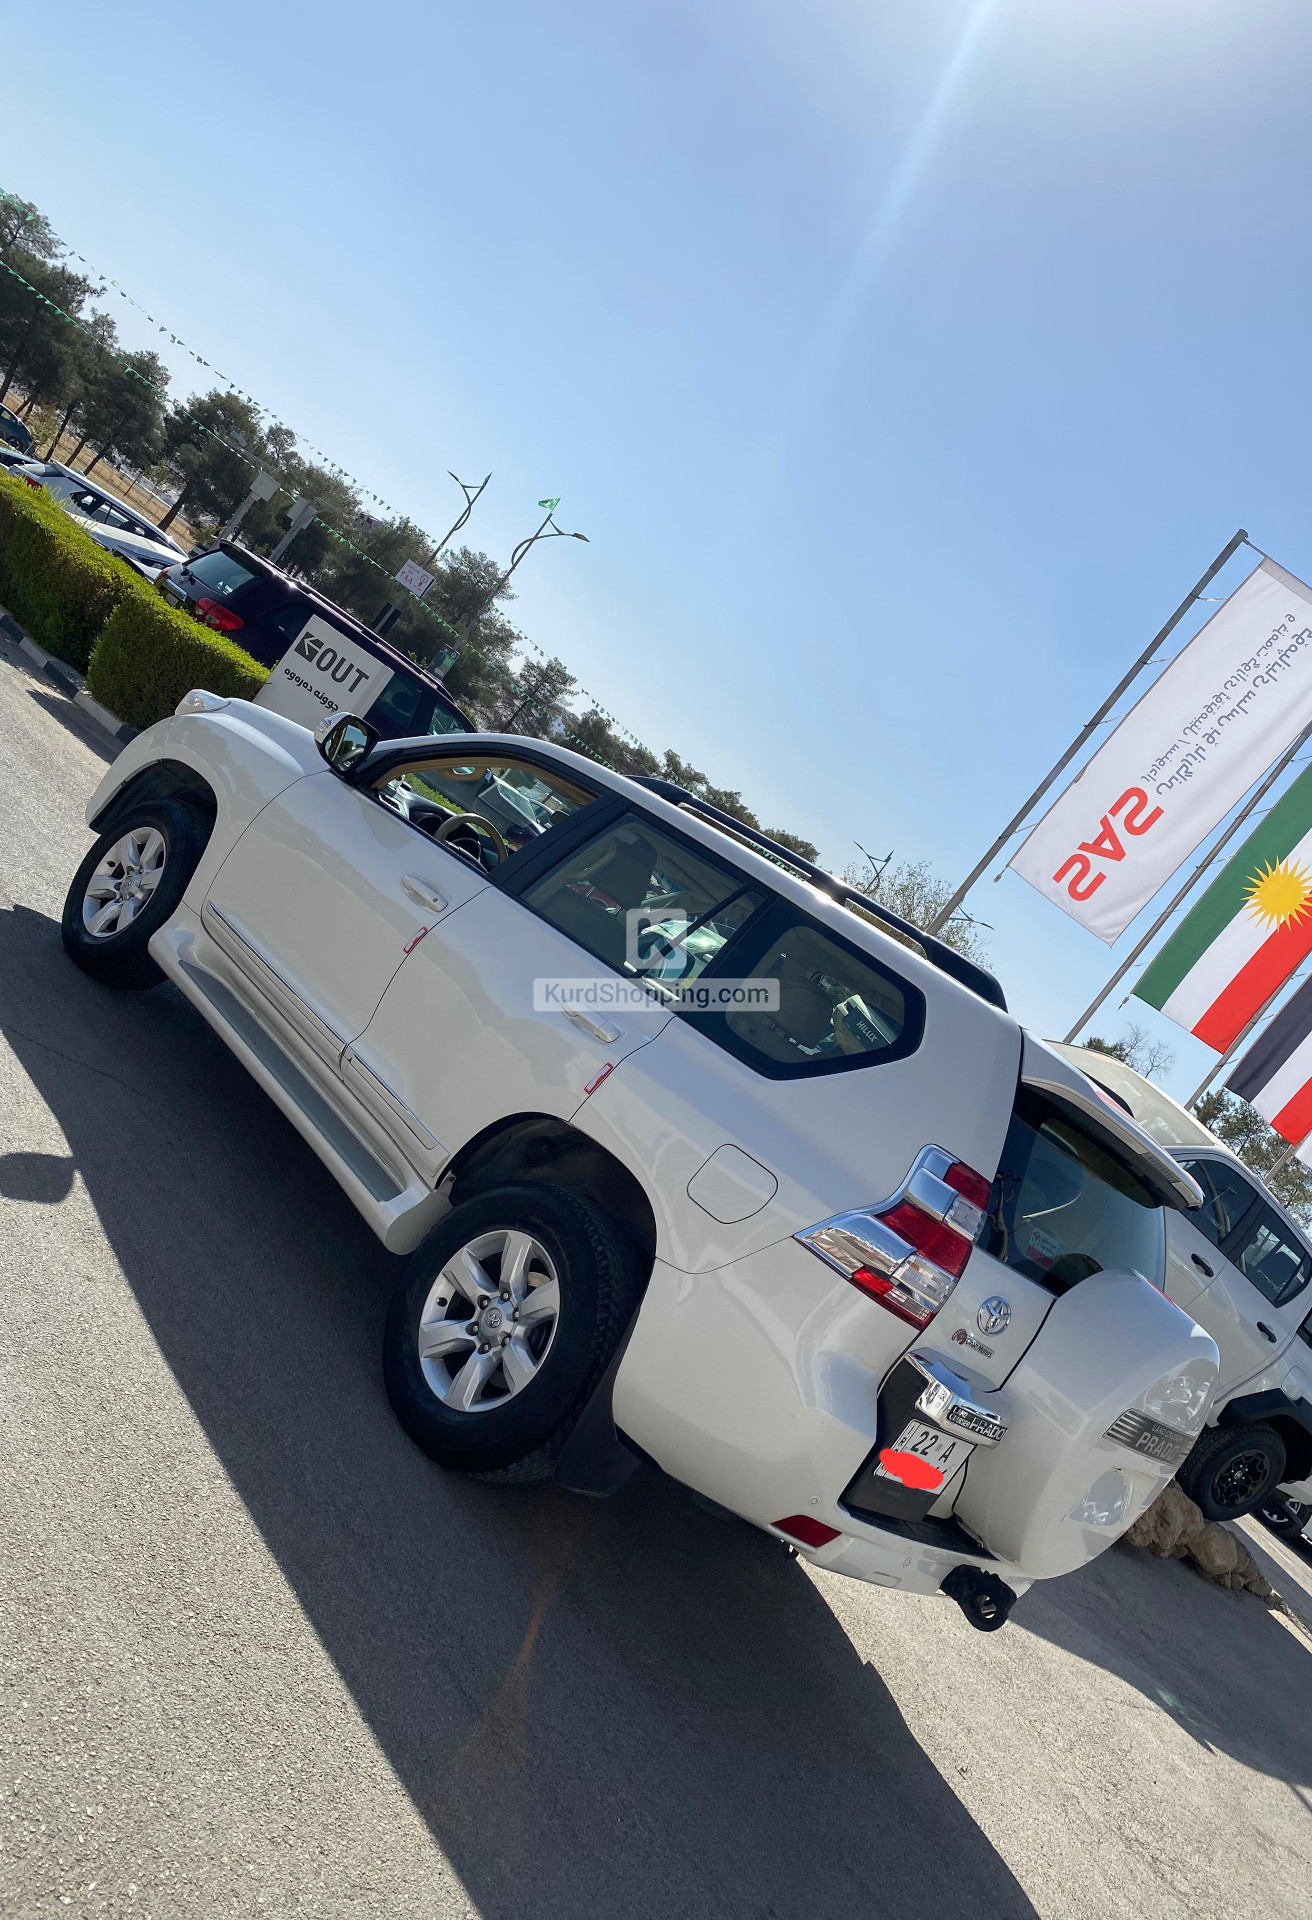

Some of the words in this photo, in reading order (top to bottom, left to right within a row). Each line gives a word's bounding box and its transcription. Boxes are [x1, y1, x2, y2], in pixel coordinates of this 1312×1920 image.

[284, 668, 313, 692] دەرەوە
[316, 648, 370, 693] OUT
[314, 690, 339, 713] چوونە
[856, 1020, 878, 1042] HILUX
[969, 1416, 1007, 1440] PRADO
[1152, 1425, 1166, 1435] LAND
[910, 1431, 939, 1456] 22
[938, 1442, 957, 1463] A
[1135, 1431, 1179, 1460] PRADO
